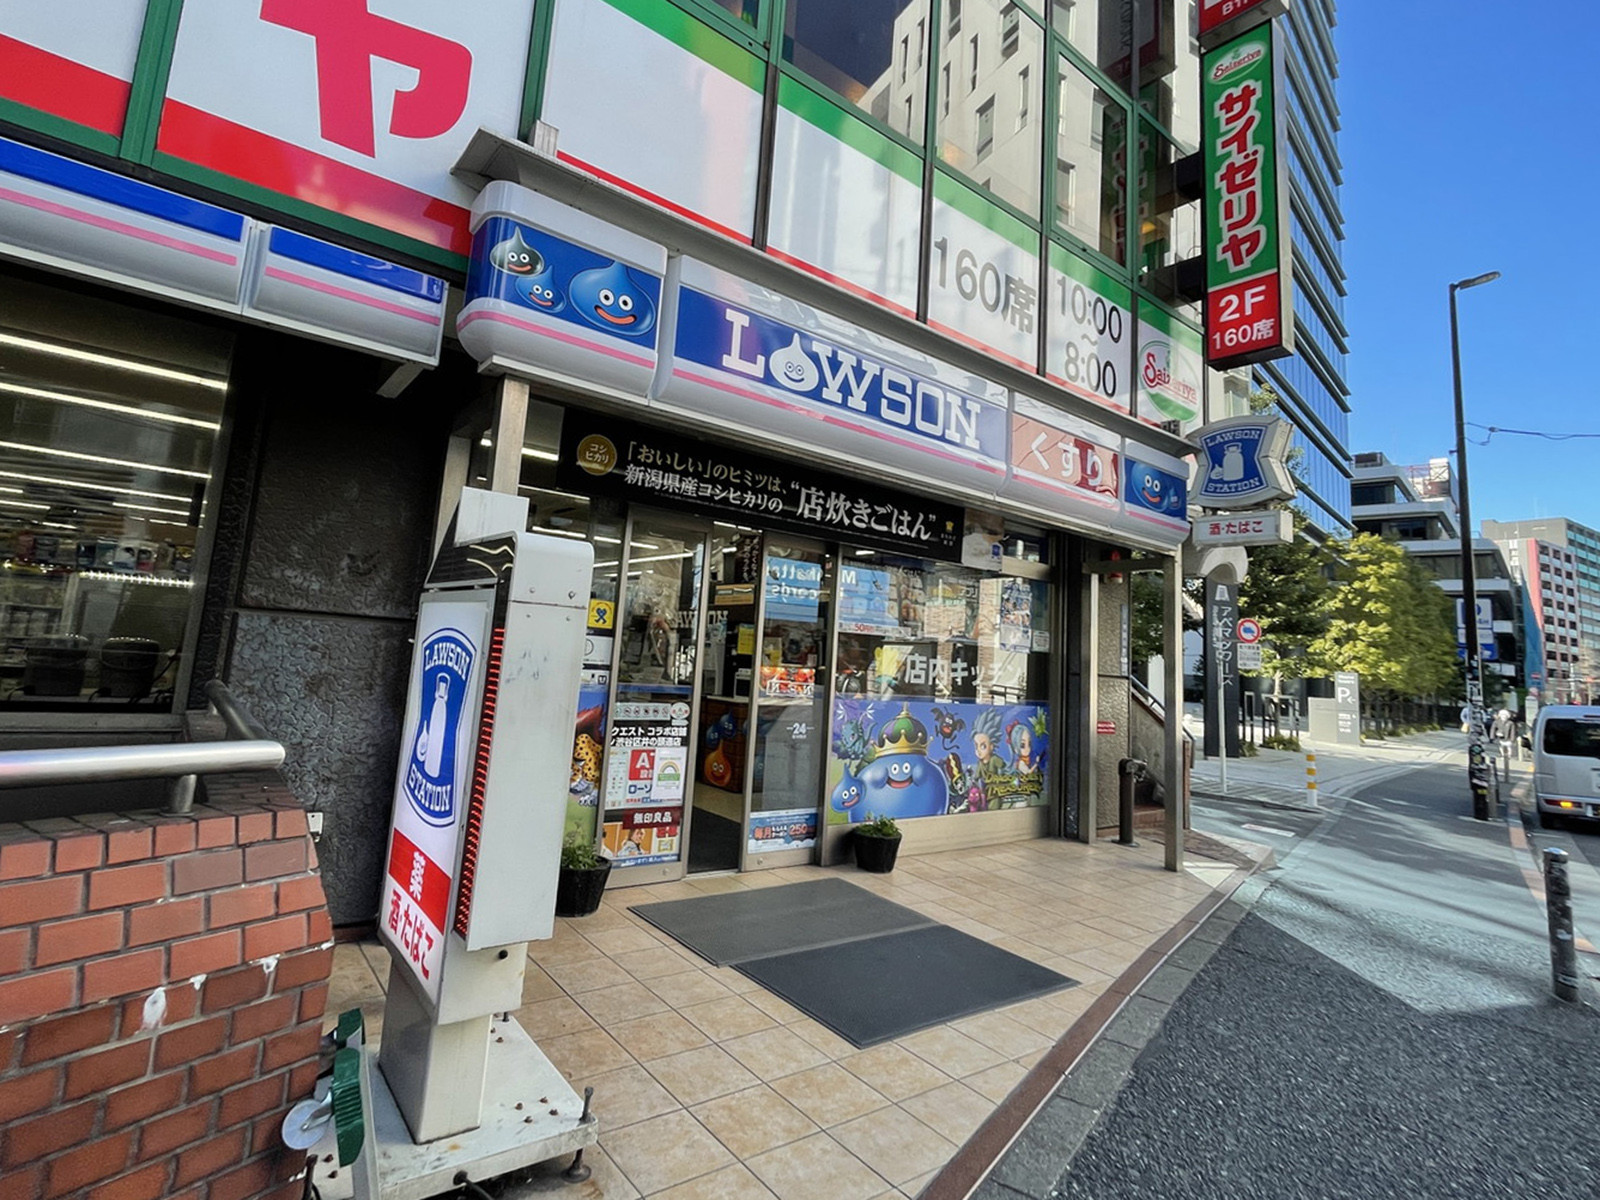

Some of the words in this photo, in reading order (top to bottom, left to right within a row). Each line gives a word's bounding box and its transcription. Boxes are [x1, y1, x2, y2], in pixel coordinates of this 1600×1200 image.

[1217, 82, 1263, 269] サイゼリヤ
[935, 237, 1036, 334] 160席
[1219, 285, 1266, 323] 2F
[1057, 276, 1122, 343] 10:00
[1213, 318, 1275, 349] 160席
[1065, 341, 1116, 397] 8:00
[585, 451, 609, 464] ヒカリ
[589, 442, 607, 453] コシ
[1031, 431, 1103, 486] くすり
[1206, 429, 1260, 447] LAWSON
[626, 440, 788, 494] 「おいしい」のヒミツは、
[1207, 477, 1260, 493] STATION
[624, 463, 784, 514] 新潟県産コシヒカリの
[424, 641, 470, 682] LAWSON
[1337, 686, 1351, 704] P
[611, 726, 646, 737] クエスト
[647, 726, 688, 737] コラボ店舗
[793, 722, 807, 735] 24
[408, 763, 452, 812] STATION
[633, 811, 673, 825] 無印良品
[409, 851, 426, 902] 薬
[388, 888, 434, 980] 酒・たばこ
